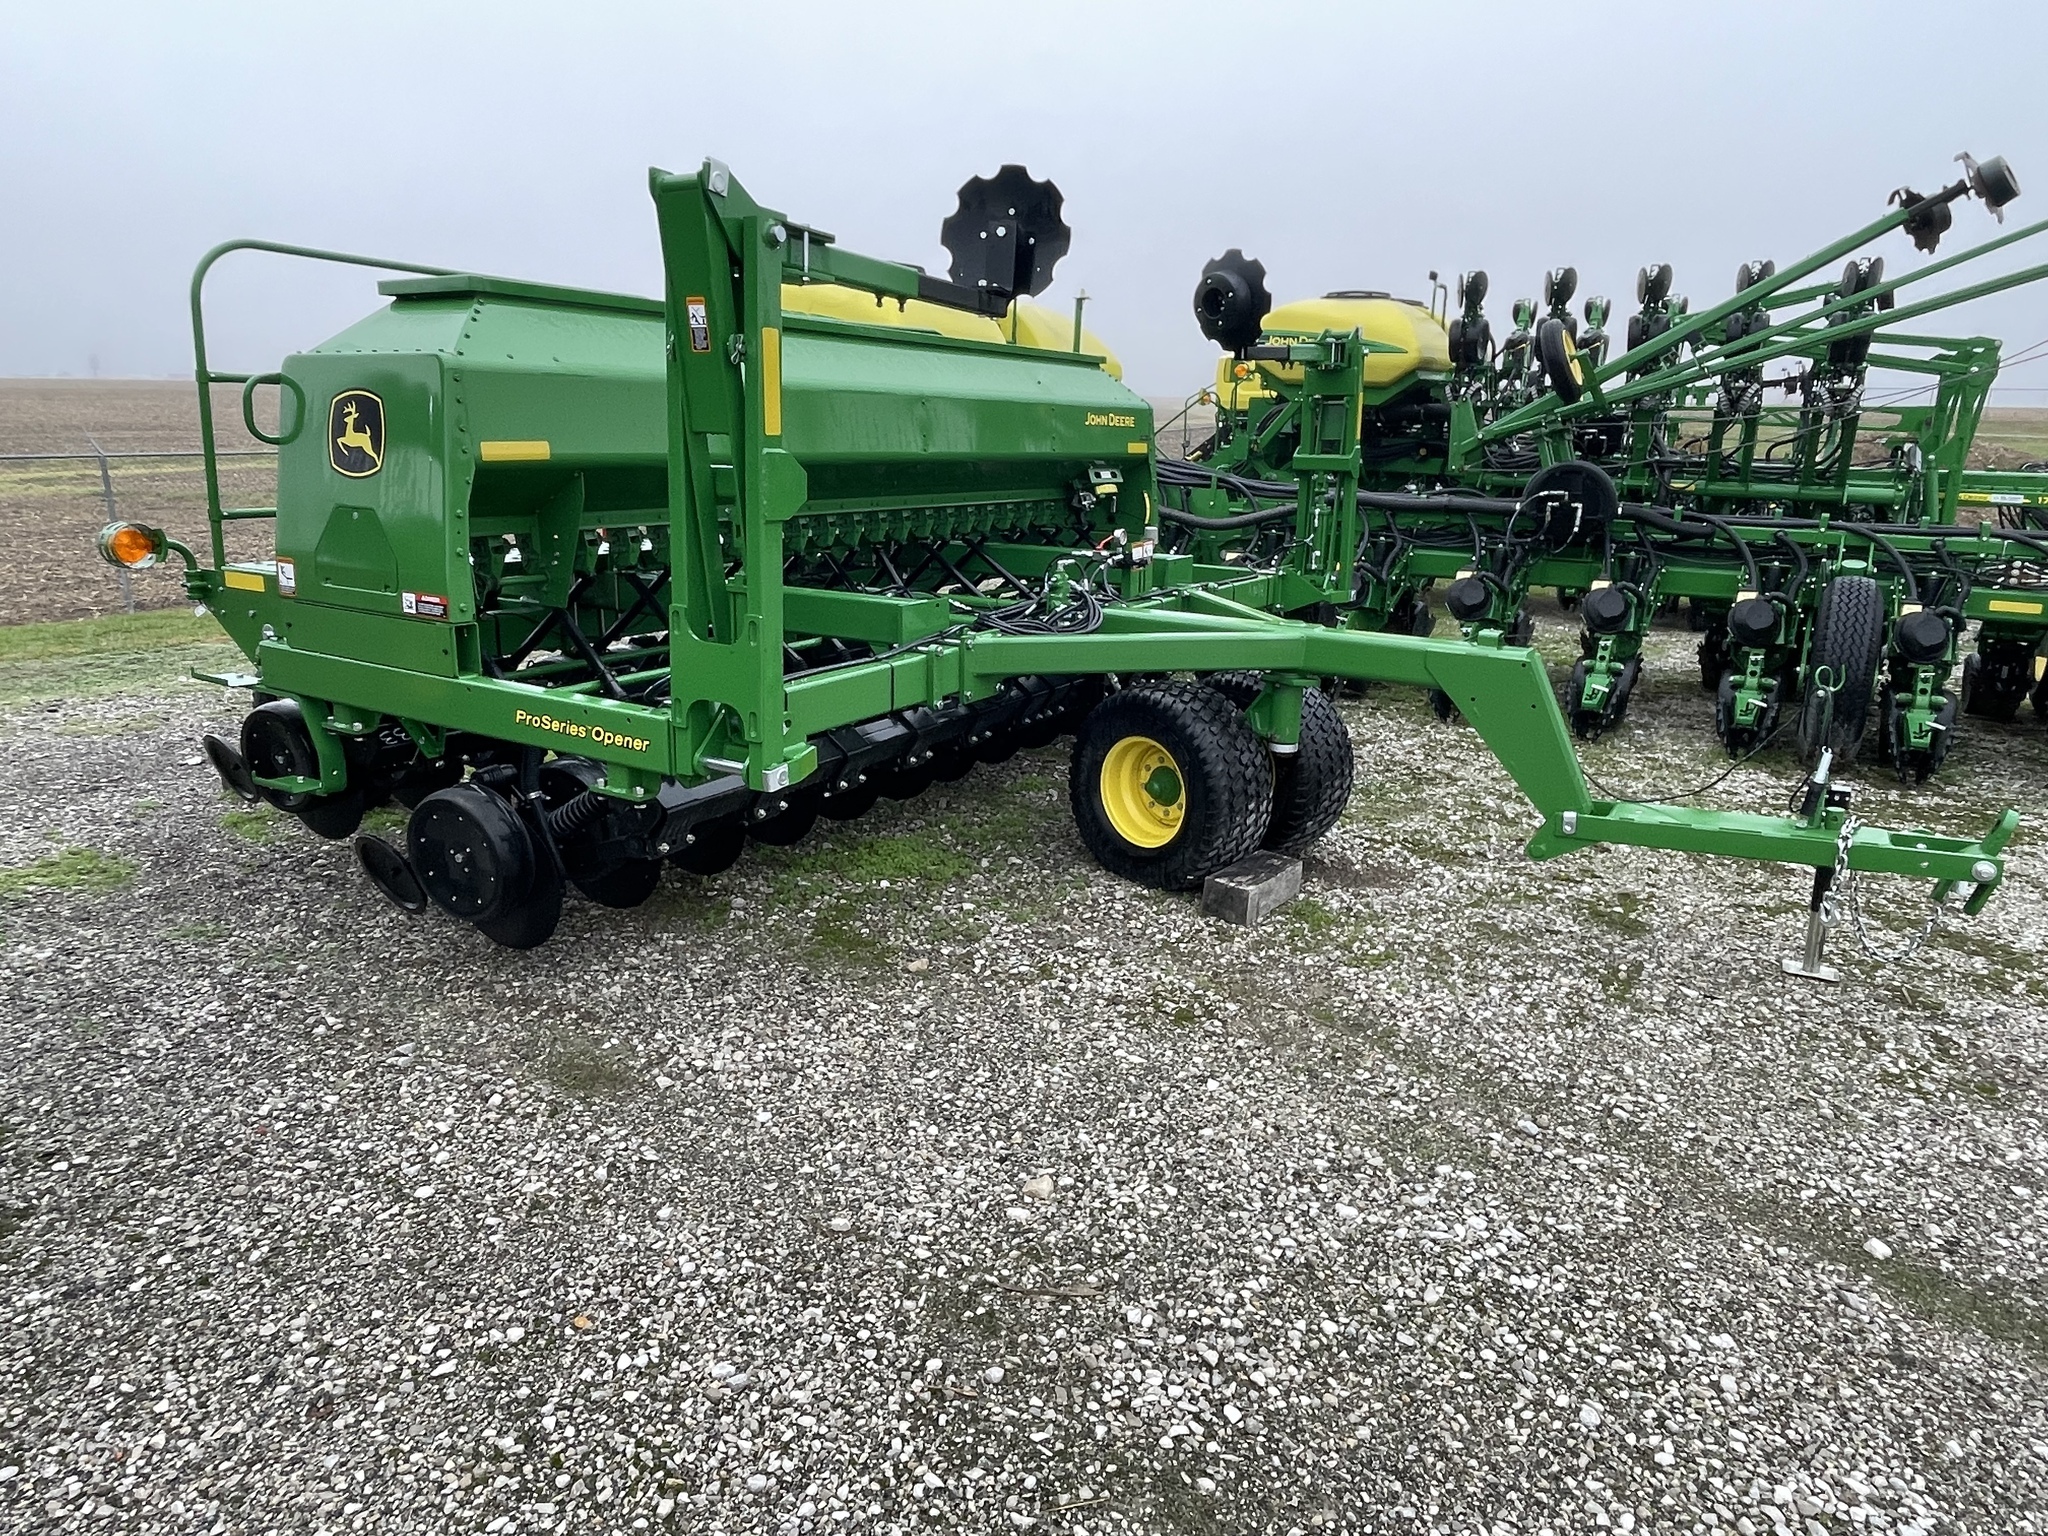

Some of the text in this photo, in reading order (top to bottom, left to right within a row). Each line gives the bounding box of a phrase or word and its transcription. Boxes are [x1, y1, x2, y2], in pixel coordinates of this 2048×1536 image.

[1266, 335, 1298, 346] JOHN
[1084, 411, 1135, 428] JOHN DEERE
[591, 726, 650, 752] Opener
